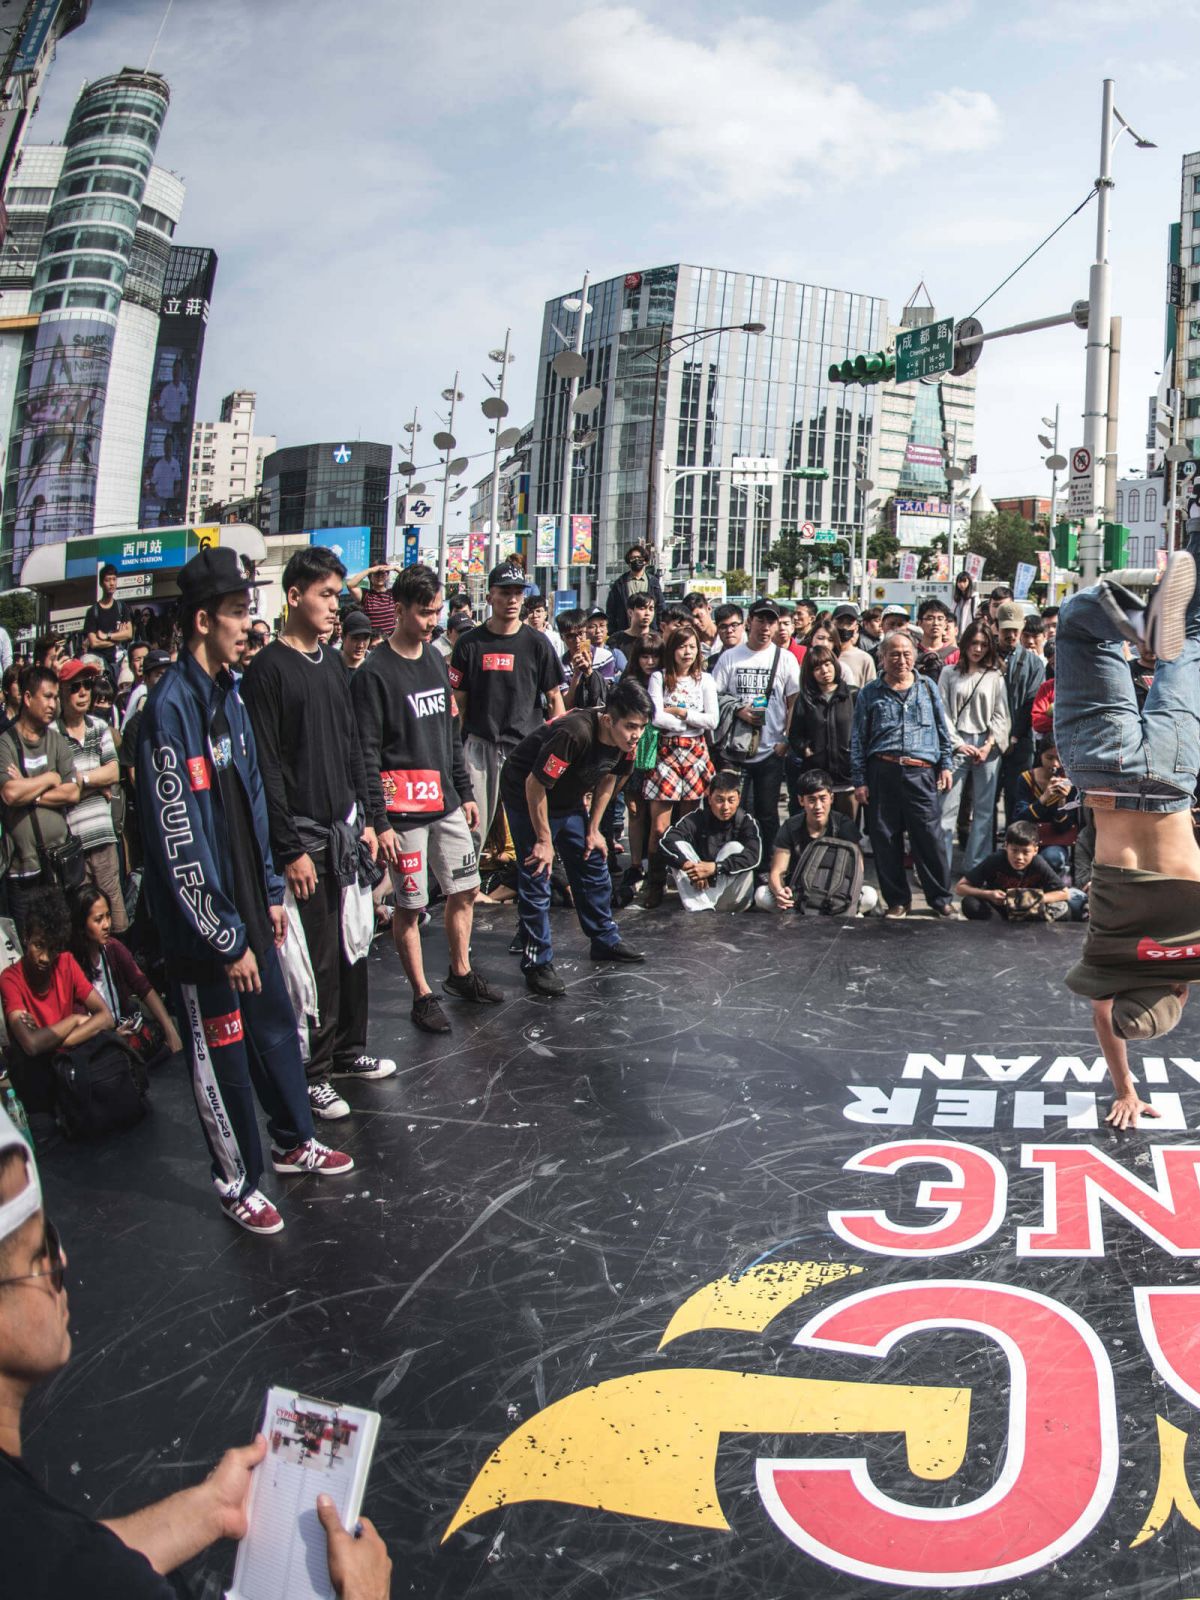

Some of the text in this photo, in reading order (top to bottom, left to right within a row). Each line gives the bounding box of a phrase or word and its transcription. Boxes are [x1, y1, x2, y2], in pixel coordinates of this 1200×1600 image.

[122, 539, 162, 557] 西門站
[139, 556, 163, 564] STATION
[496, 656, 510, 666] 125
[407, 687, 446, 719] VANS
[405, 781, 439, 801] 123
[152, 746, 194, 860] SOUL
[402, 857, 418, 868] 123
[1146, 947, 1196, 958] 126
[205, 1085, 220, 1111] SOUL
